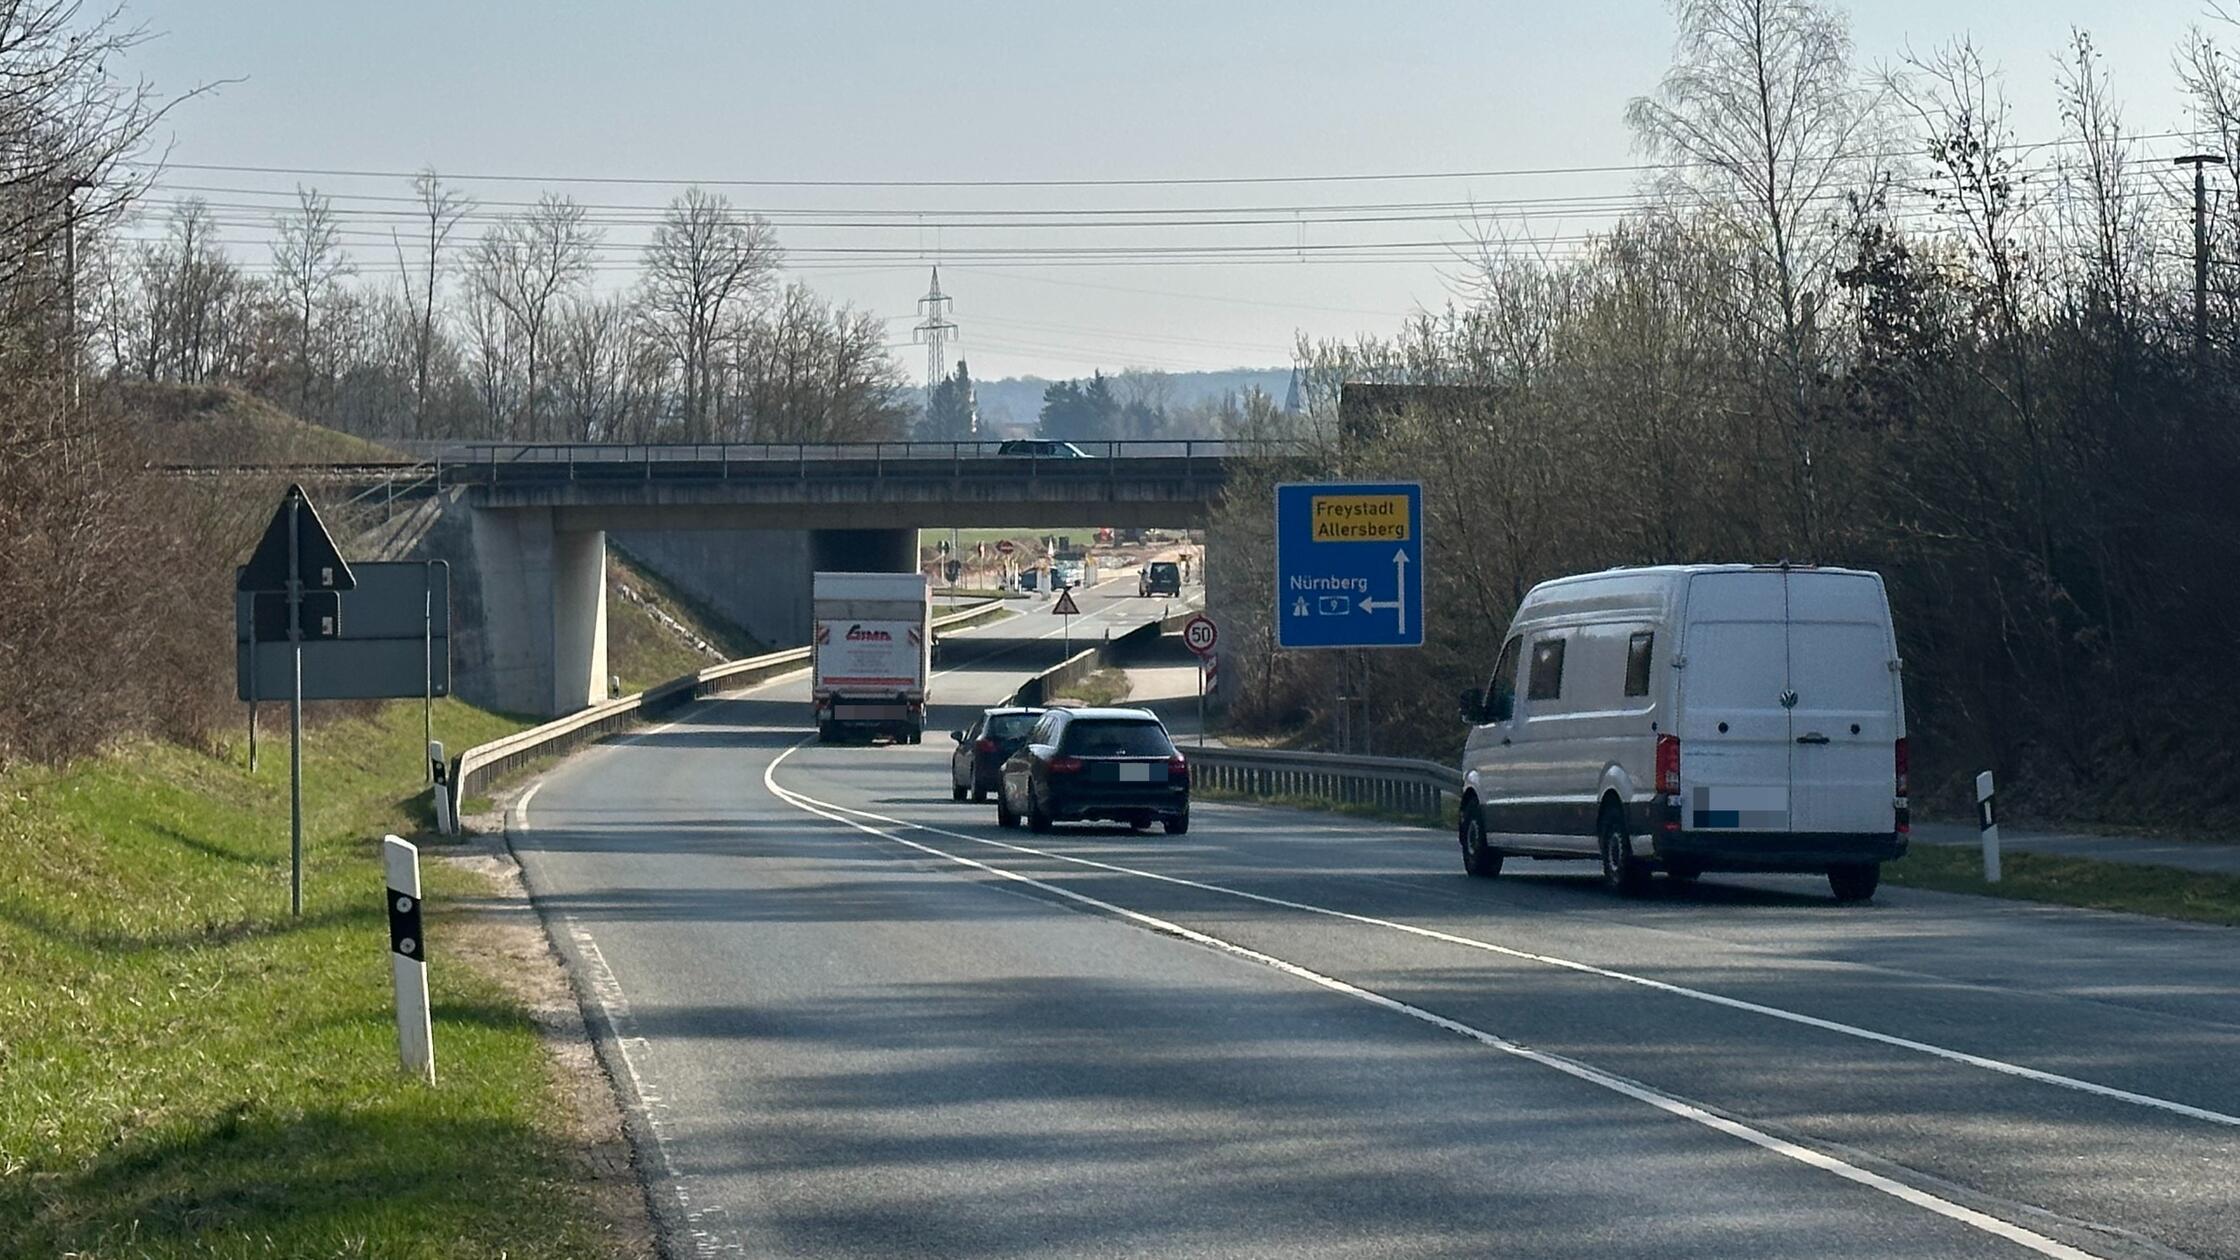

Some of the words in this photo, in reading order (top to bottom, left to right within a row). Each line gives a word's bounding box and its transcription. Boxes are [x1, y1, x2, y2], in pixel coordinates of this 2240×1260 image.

[1316, 501, 1394, 519] Freystadt
[1318, 522, 1405, 539] Allersberg
[1290, 575, 1368, 593] Nürnberg
[1330, 600, 1338, 611] 9
[1192, 627, 1211, 642] 50
